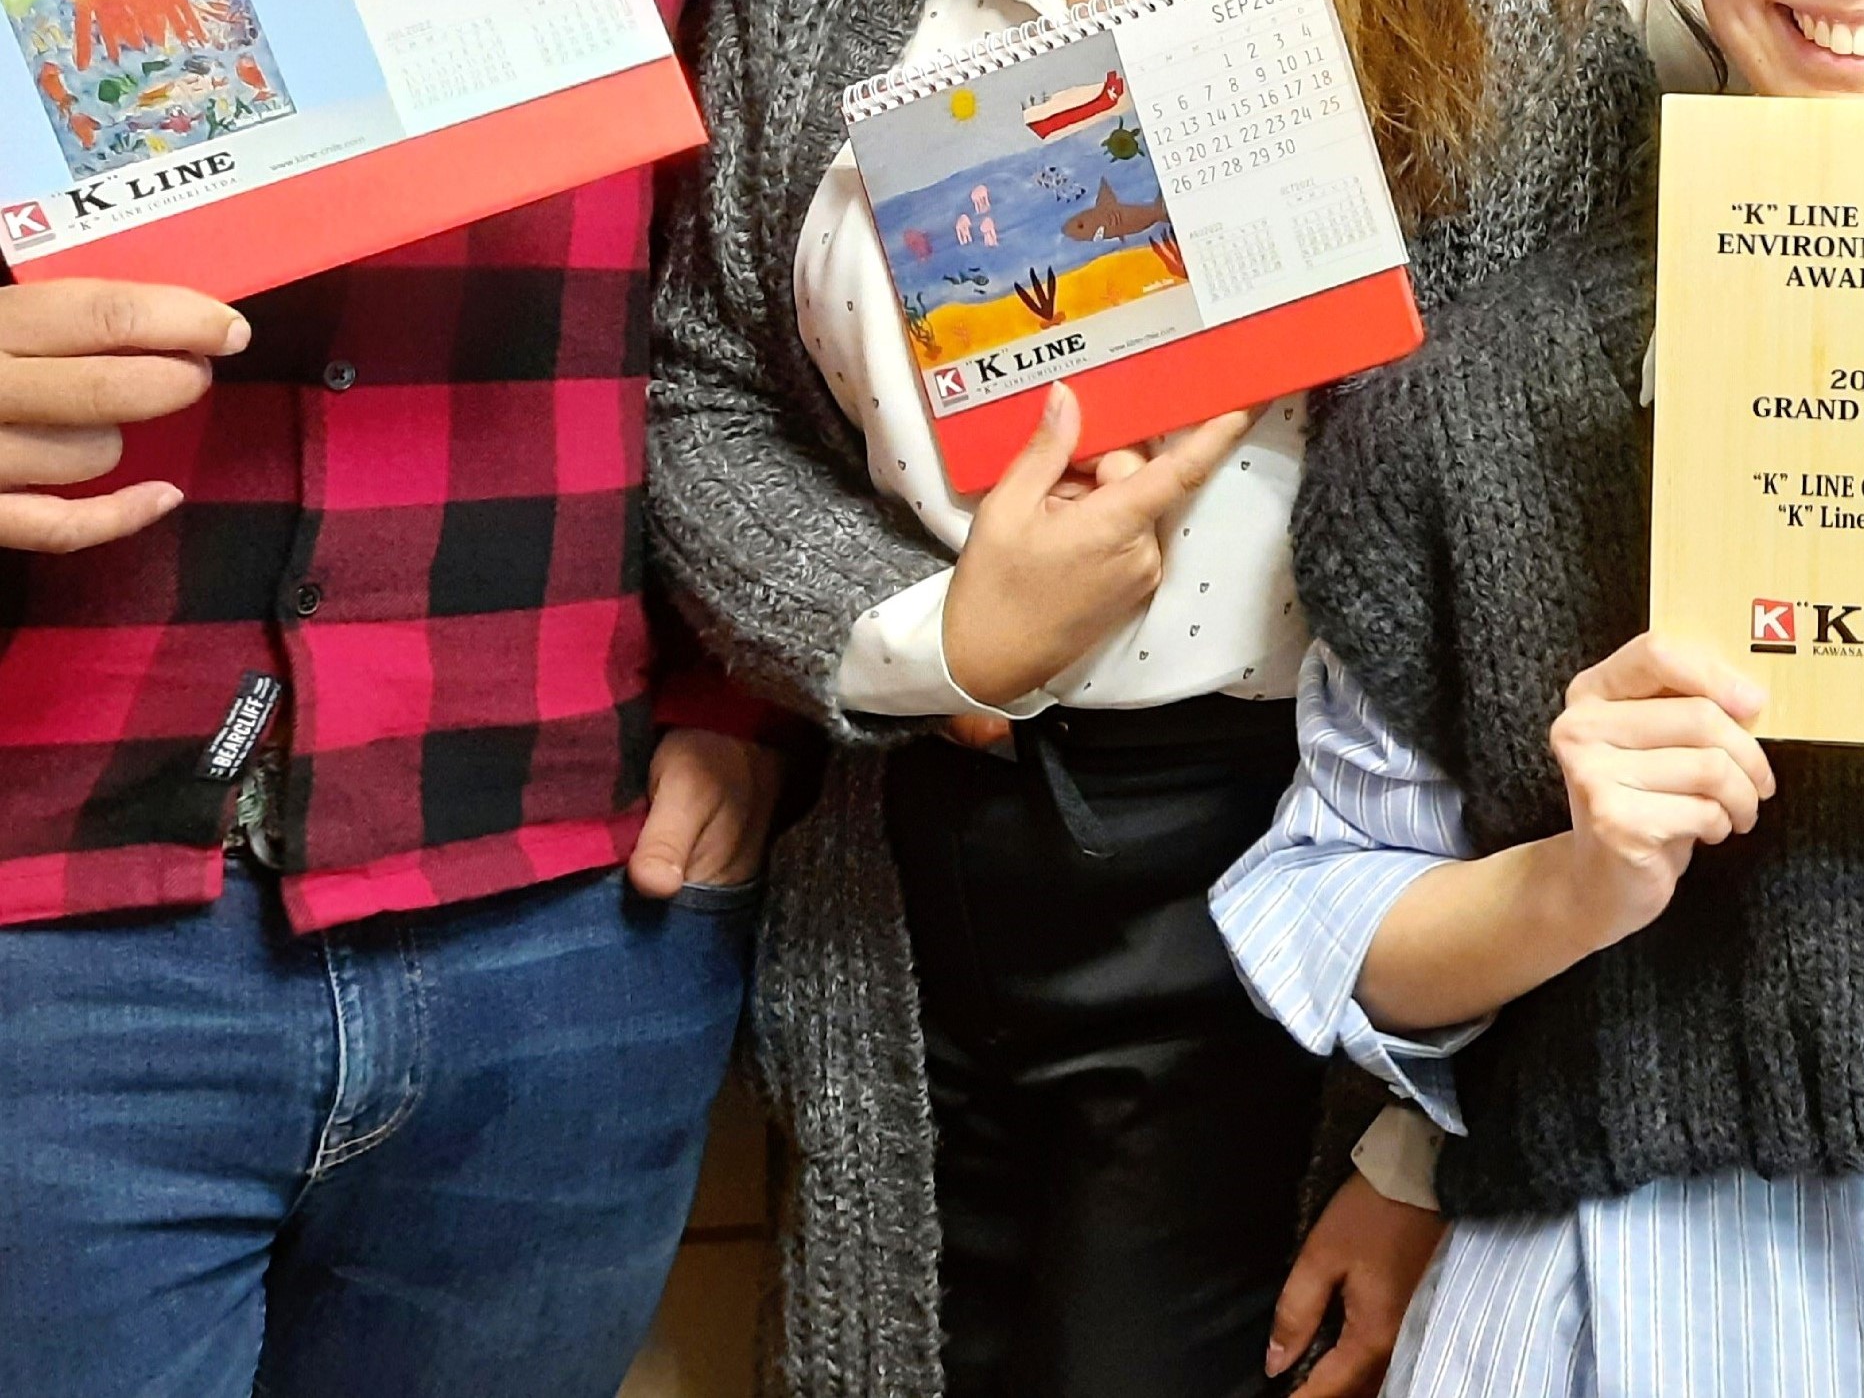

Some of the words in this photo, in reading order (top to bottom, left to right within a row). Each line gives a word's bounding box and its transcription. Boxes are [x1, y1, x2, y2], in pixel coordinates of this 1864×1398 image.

[1224, 54, 1232, 67] 1
[1247, 43, 1258, 59] 2
[1274, 33, 1284, 49] 3
[1302, 23, 1312, 38] 4
[1152, 103, 1162, 119] 5
[1178, 95, 1188, 110] 6
[1205, 85, 1211, 101] 7
[1229, 78, 1239, 92] 8
[1256, 67, 1266, 82] 9
[1277, 55, 1297, 74] 10
[1304, 46, 1324, 66] 11
[1154, 126, 1174, 146] 12
[1180, 116, 1200, 136] 13
[1207, 109, 1226, 127] 14
[1231, 98, 1251, 118] 15
[1258, 90, 1278, 108] 16
[1284, 79, 1301, 99] 17
[1312, 70, 1332, 90] 18
[1162, 151, 1181, 171] 19
[1186, 143, 1206, 162] 20
[1212, 134, 1234, 152] 21
[1239, 124, 1261, 143] 22
[1265, 114, 1285, 134] 23
[1291, 106, 1312, 125] 24
[1320, 95, 1340, 115] 25
[127, 151, 236, 201] LINE
[1171, 175, 1192, 194] 26
[1197, 165, 1216, 185] 27
[1221, 158, 1243, 176] 28
[1249, 148, 1270, 167] 29
[1275, 139, 1295, 158] 30
[3, 205, 47, 240] K
[1786, 204, 1860, 230] LINE
[1014, 333, 1087, 371] LINE
[934, 370, 965, 398] K
[1752, 396, 1861, 422] GRAND
[1800, 474, 1856, 500] LINE
[1753, 603, 1790, 639] K
[211, 695, 265, 768] BEARCLIFF
